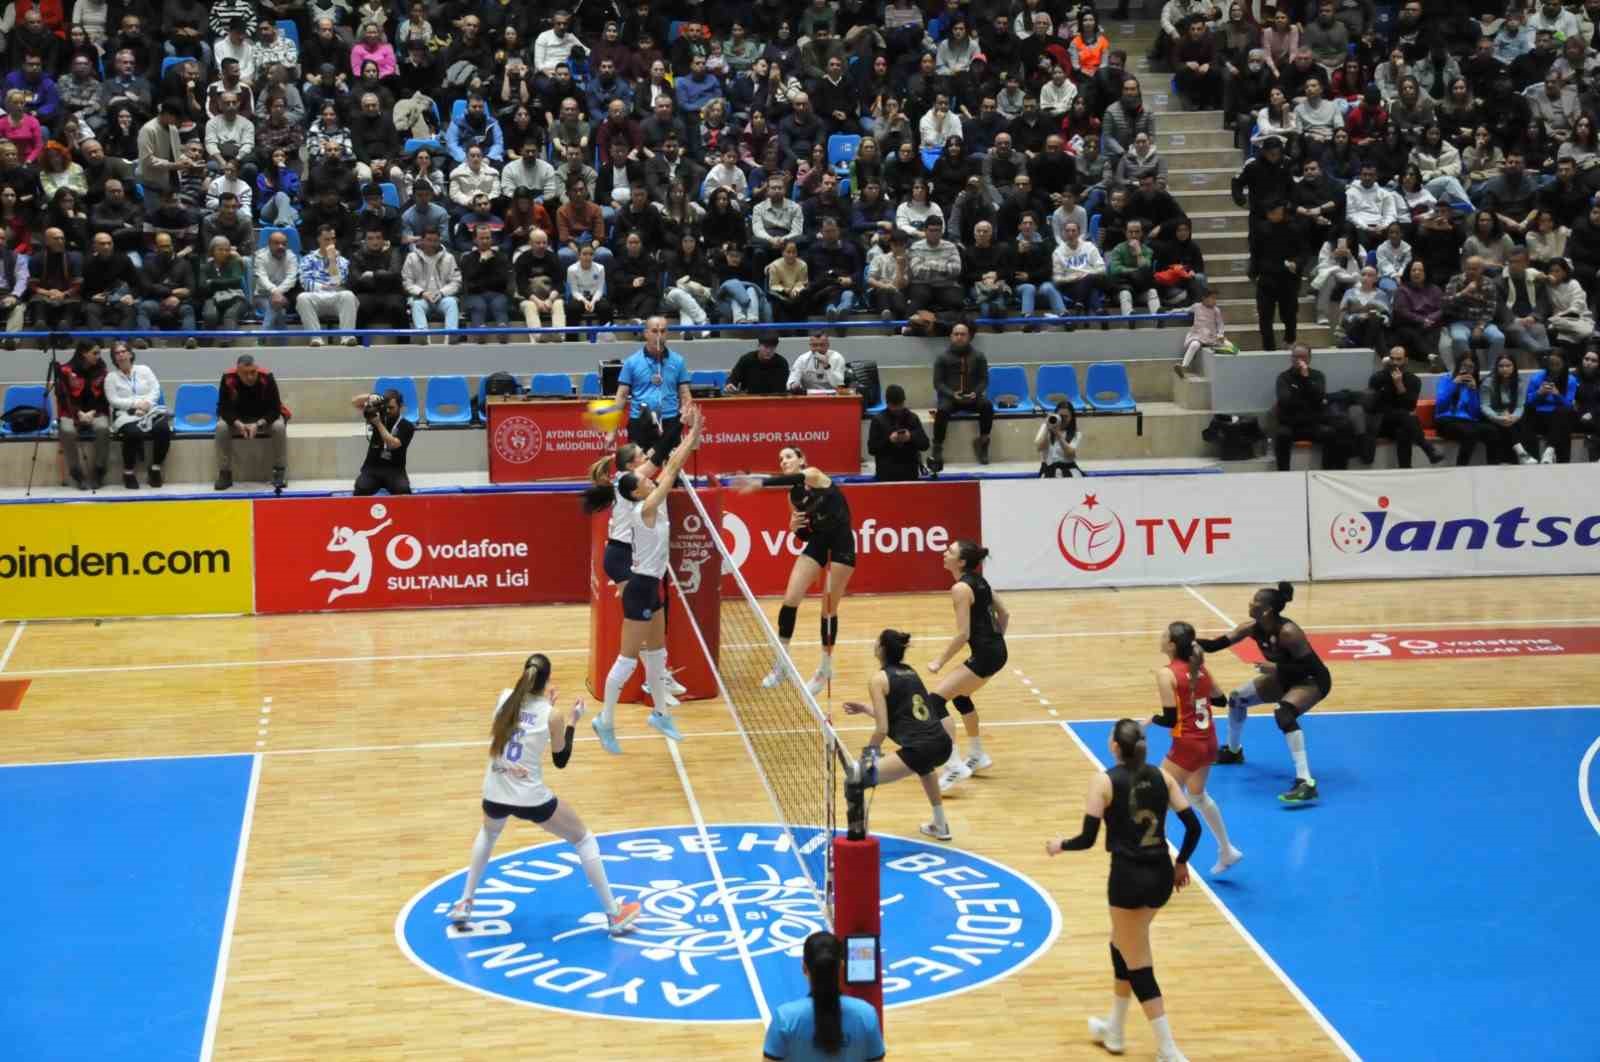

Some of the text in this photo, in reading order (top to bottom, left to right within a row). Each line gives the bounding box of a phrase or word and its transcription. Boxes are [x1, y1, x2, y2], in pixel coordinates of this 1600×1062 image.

[545, 430, 575, 439] AYDIN
[715, 431, 750, 443] SİNAN
[752, 431, 782, 442] SPOR
[784, 430, 830, 442] SALONU
[427, 539, 529, 559] vodafone
[760, 518, 949, 556] vofone
[1135, 517, 1232, 556] TVF
[387, 574, 488, 590] SULTANLAR
[1195, 697, 1210, 730] 5
[1134, 809, 1162, 847] 2
[466, 942, 724, 1008] AYDIN
